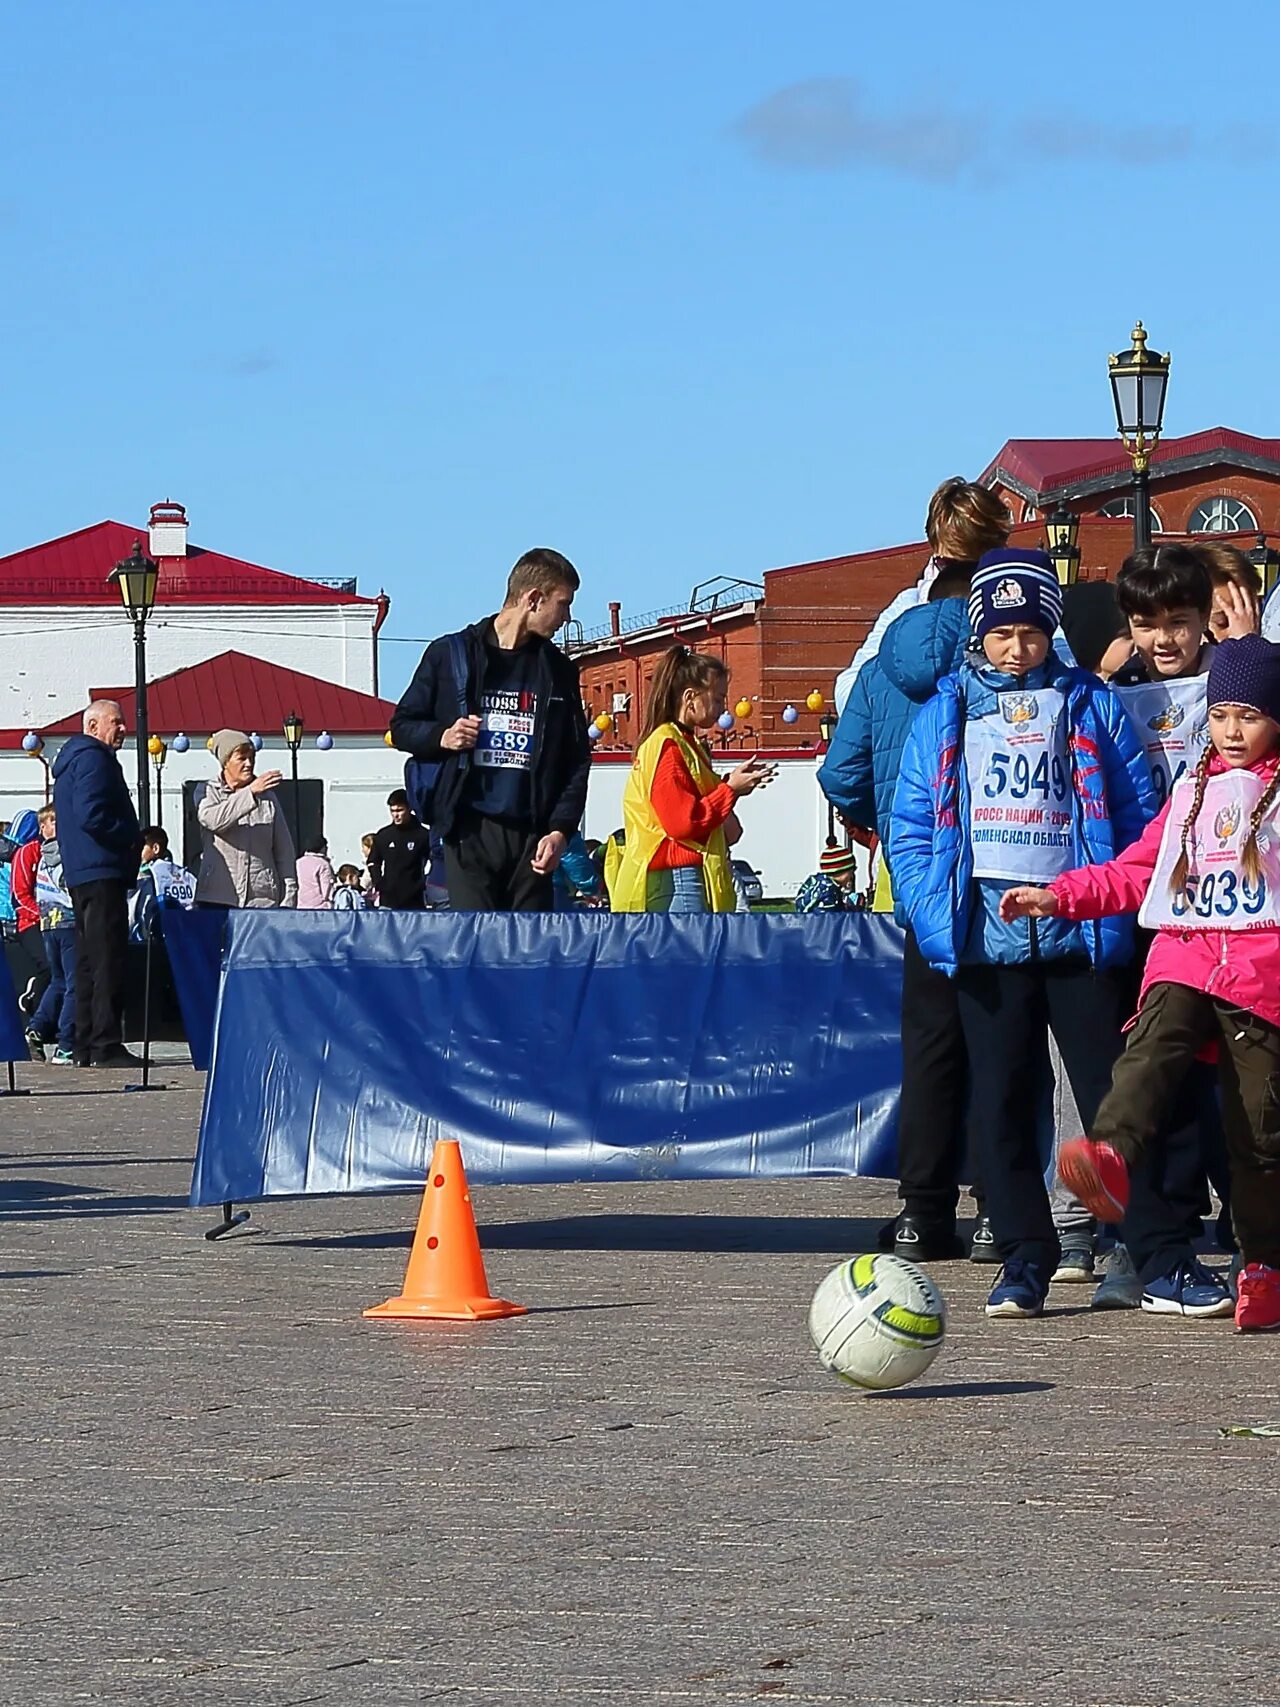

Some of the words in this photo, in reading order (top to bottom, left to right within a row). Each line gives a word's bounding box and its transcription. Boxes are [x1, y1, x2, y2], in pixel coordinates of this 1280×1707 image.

[490, 732, 529, 751] 689
[984, 751, 1067, 802] 5949
[1006, 809, 1043, 826] НАЦИИ
[1033, 831, 1073, 847] ОБЛАСТЬ
